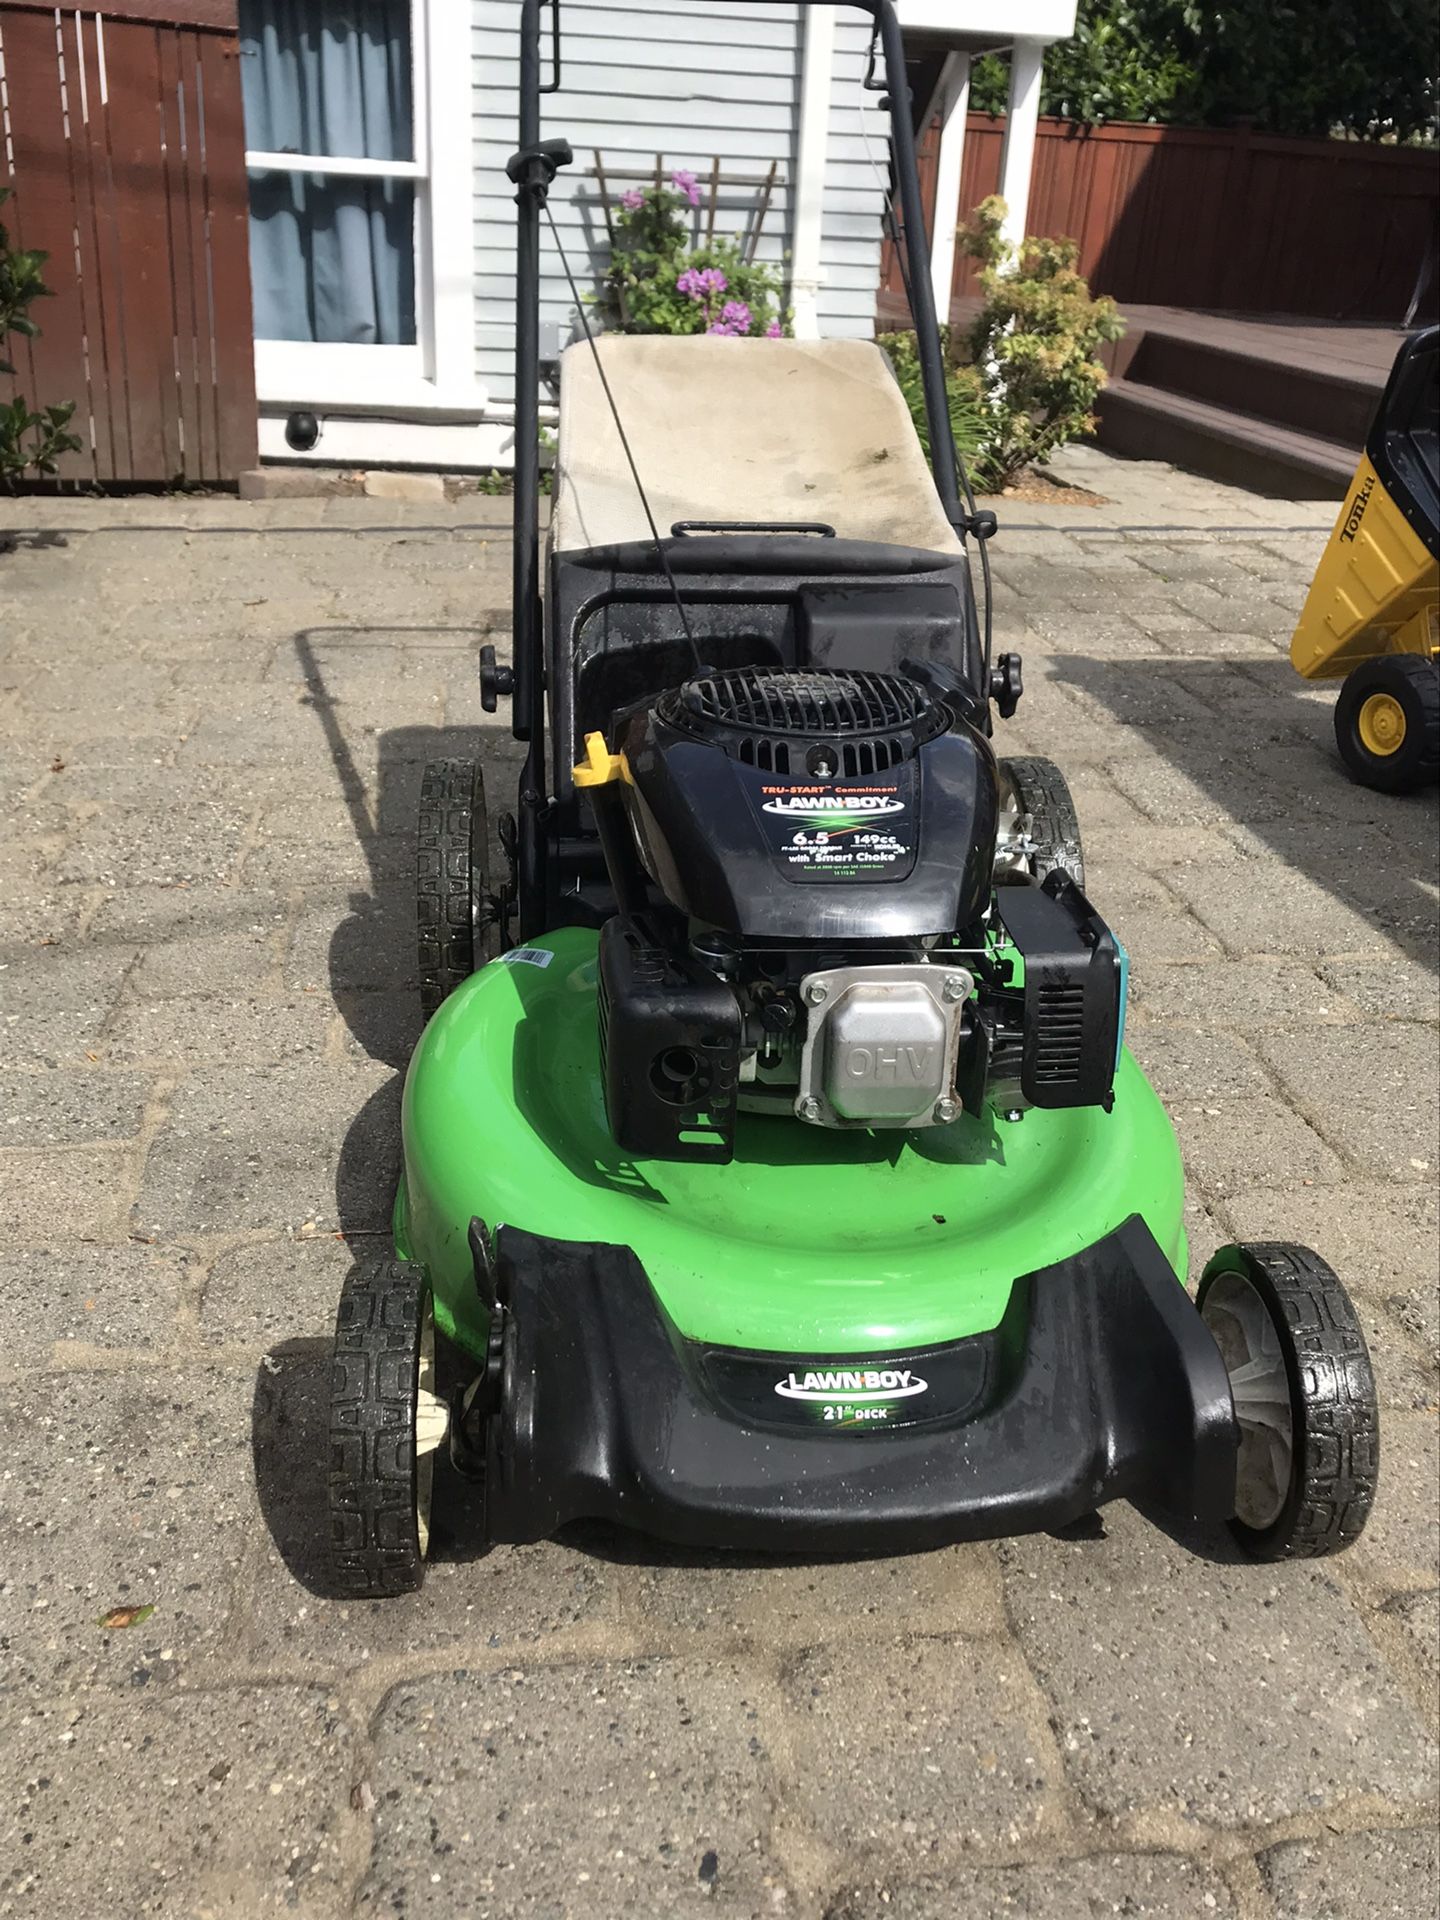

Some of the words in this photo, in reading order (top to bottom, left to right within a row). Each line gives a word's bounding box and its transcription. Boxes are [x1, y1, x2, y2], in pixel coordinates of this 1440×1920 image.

[1340, 475, 1376, 543] Tonka
[835, 786, 898, 794] Commitment
[792, 831, 830, 845] 6.5
[853, 834, 897, 844] 149cc
[788, 854, 810, 863] with
[815, 853, 853, 862] Smart
[855, 852, 896, 862] Choke
[846, 1047, 934, 1081] OHV
[855, 1409, 888, 1419] DECK
